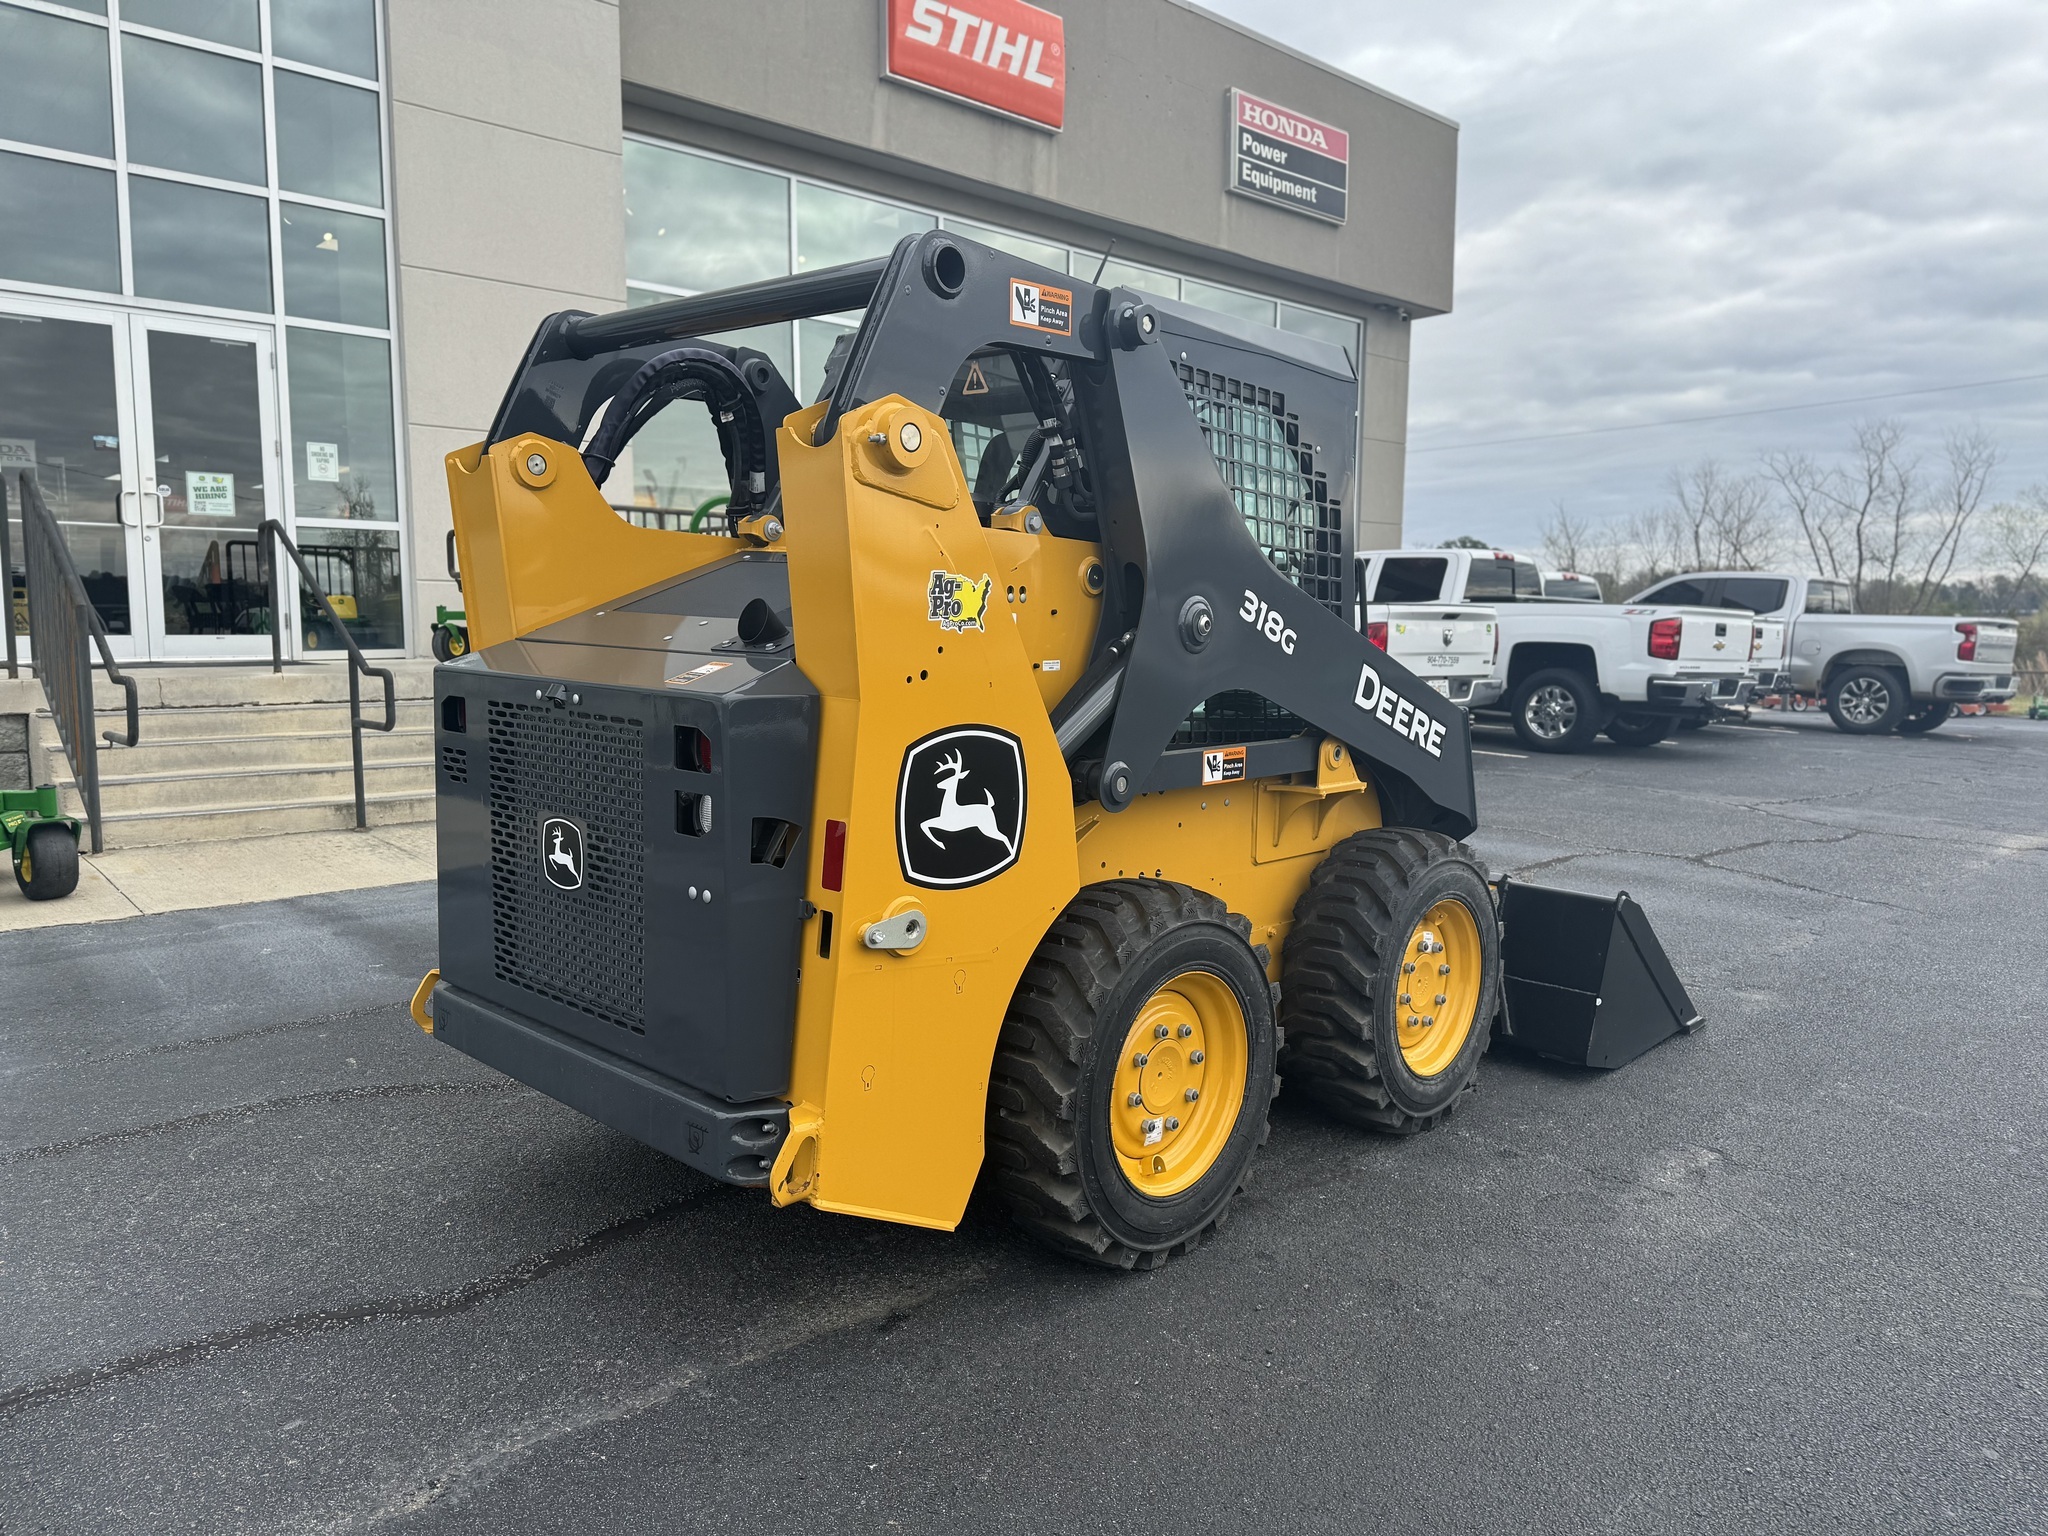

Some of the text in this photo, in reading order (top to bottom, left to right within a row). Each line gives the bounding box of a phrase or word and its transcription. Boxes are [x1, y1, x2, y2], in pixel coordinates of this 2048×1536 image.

[905, 0, 1055, 88] STIHL
[1242, 101, 1328, 150] HONDA
[1242, 132, 1288, 165] Power
[1242, 162, 1317, 203] Equipment
[1046, 290, 1070, 302] WARNING
[1040, 305, 1068, 318] Pinch Area
[1040, 315, 1064, 327] Keep Away
[193, 486, 208, 494] WE
[930, 573, 961, 599] Ag-
[931, 596, 962, 617] Pro
[1239, 589, 1298, 655] 318G
[1354, 663, 1447, 758] DEERE
